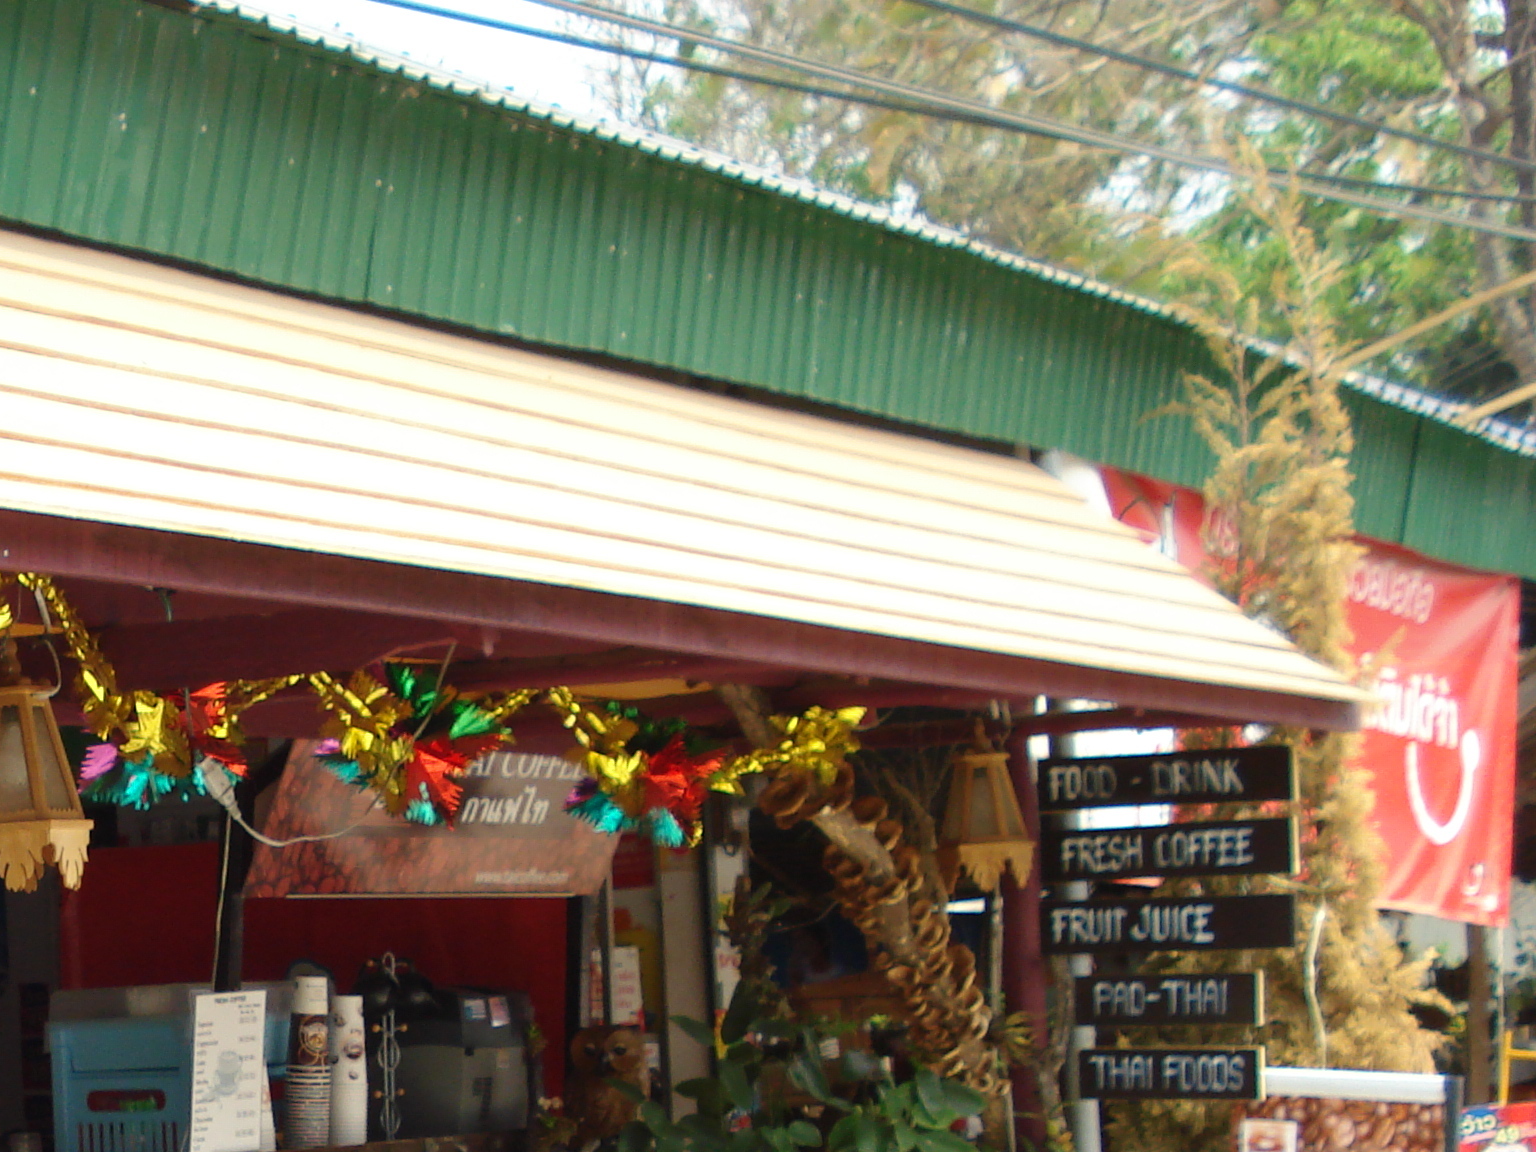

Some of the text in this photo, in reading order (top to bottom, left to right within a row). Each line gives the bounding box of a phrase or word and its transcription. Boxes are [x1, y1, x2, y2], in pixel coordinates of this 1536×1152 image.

[1048, 764, 1116, 801] FOOD
[1150, 758, 1245, 795] DRINK
[1060, 826, 1255, 873] FRESH COFFEE
[1050, 903, 1215, 944] FRUIT JUICE
[1088, 1053, 1246, 1093] THAI FOODS
